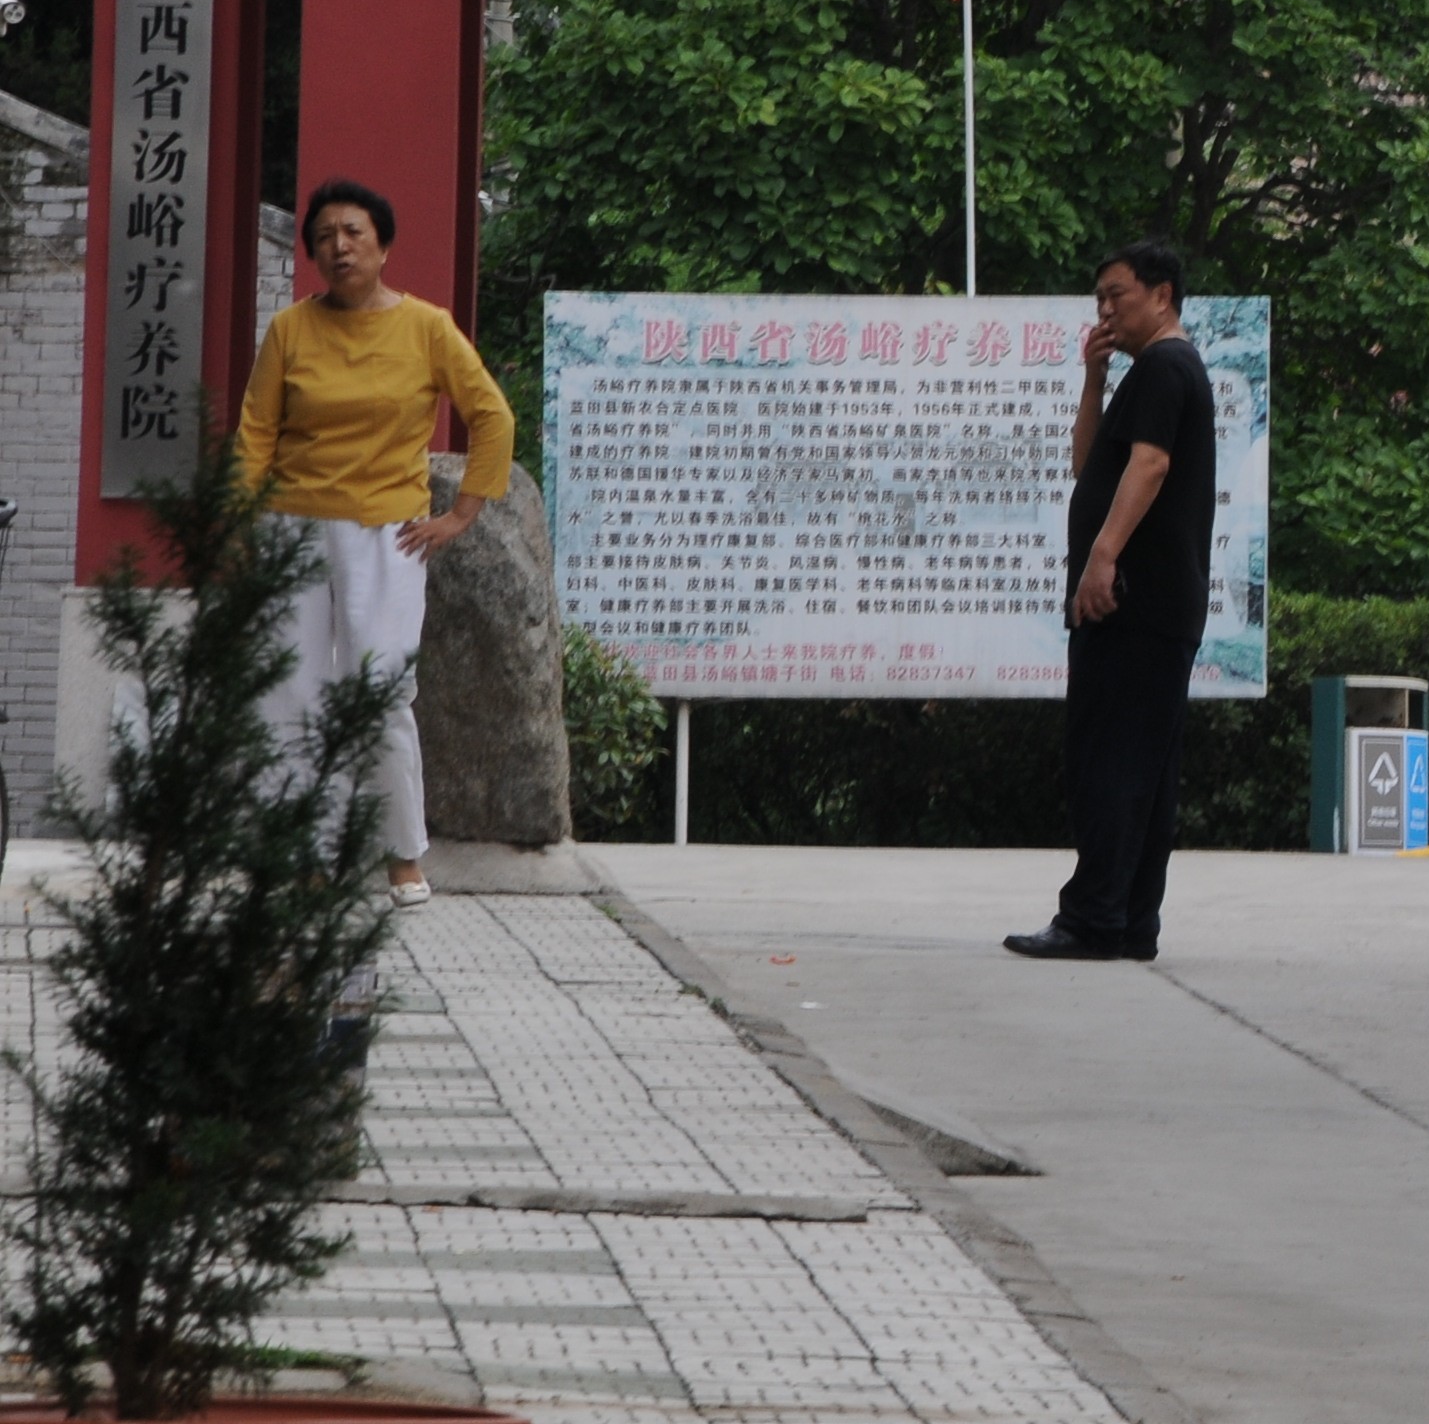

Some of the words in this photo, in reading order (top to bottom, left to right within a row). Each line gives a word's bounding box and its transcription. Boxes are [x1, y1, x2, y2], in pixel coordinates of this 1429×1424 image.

[566, 620, 759, 638] 型会议和健康疗养团队。
